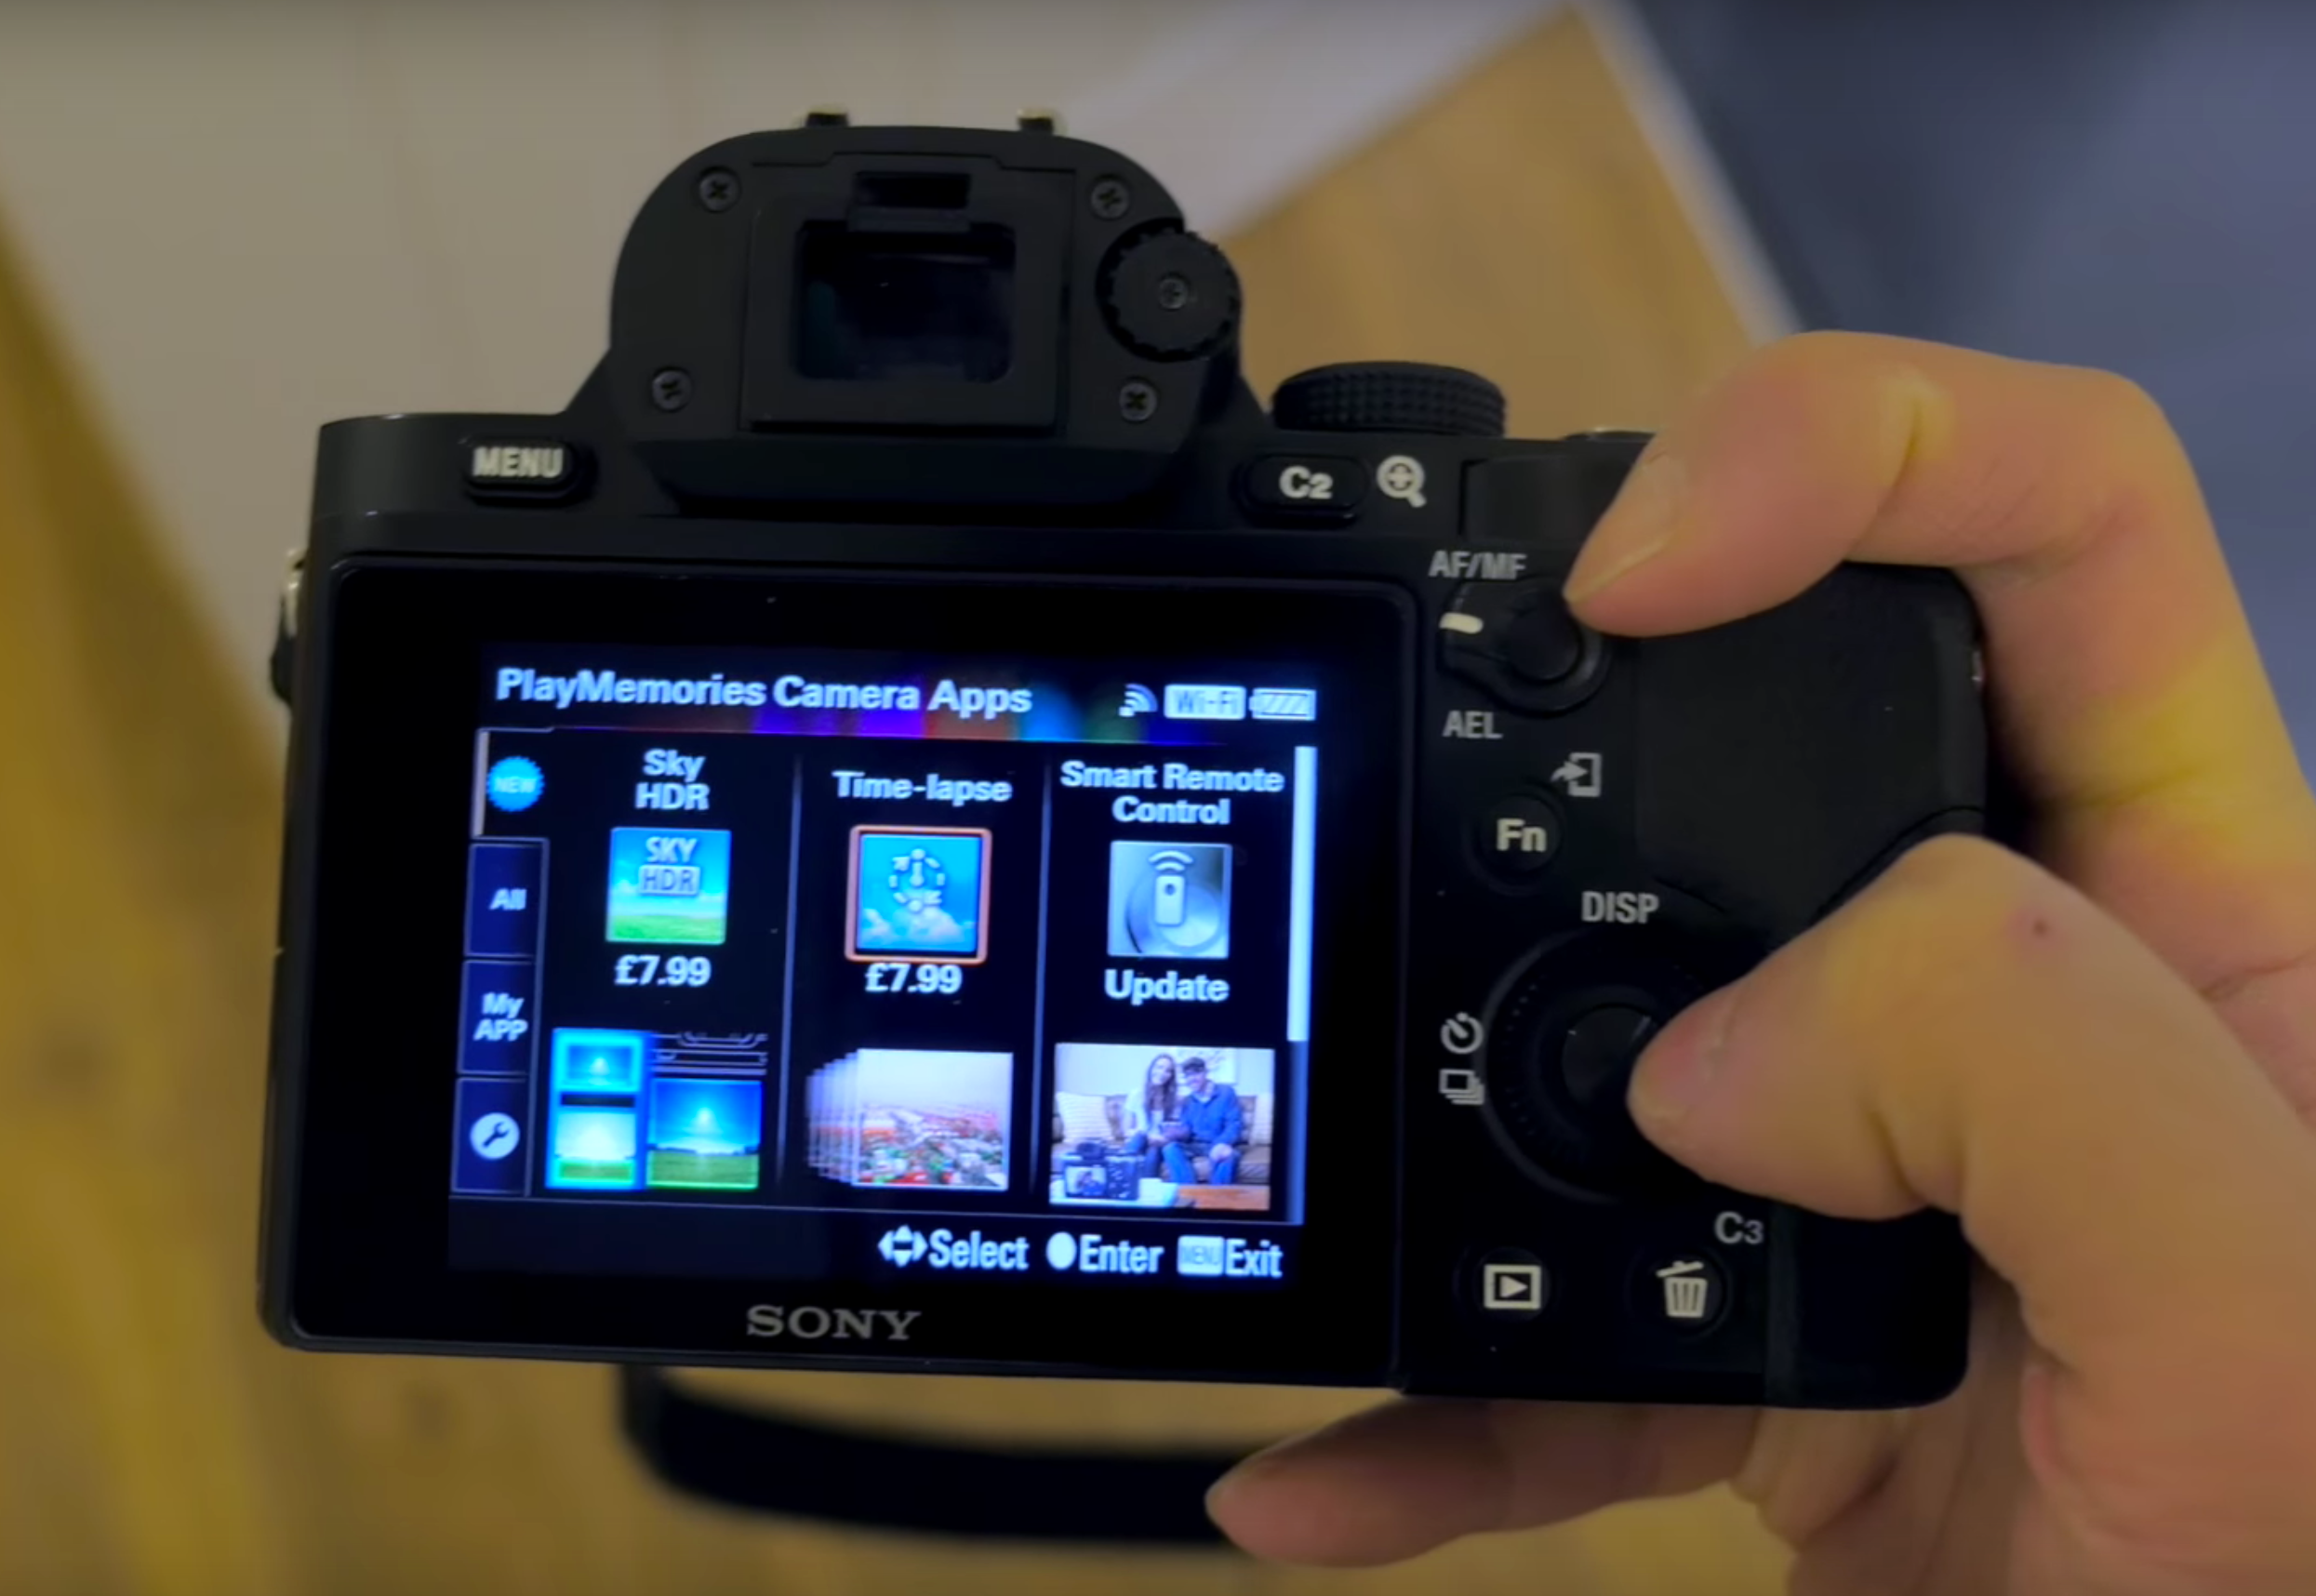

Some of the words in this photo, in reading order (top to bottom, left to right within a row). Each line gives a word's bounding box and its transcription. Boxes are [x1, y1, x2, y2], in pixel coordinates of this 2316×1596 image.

[473, 446, 564, 478] MENU
[1279, 465, 1334, 499] C2
[1429, 550, 1527, 580] AF/MF
[496, 667, 766, 709] PlayMemories
[773, 675, 921, 710] Camera
[927, 679, 1032, 720] Apps
[1443, 711, 1503, 739] AEL
[643, 749, 705, 782] Sky
[1060, 760, 1157, 789] Smart
[1163, 763, 1284, 792] Remote
[634, 783, 710, 810] HDR
[832, 770, 1013, 806] Time-lapse
[1111, 795, 1231, 825] Control
[646, 837, 698, 863] SKY
[1496, 818, 1547, 852] Fn
[642, 868, 697, 893] HDR
[489, 888, 526, 911] All
[1581, 890, 1659, 924] DISP
[613, 954, 712, 986] £7.99
[864, 963, 963, 994] £7.99
[1105, 969, 1230, 1005] Update
[482, 993, 524, 1018] My
[474, 1019, 527, 1042] APP
[1714, 1212, 1764, 1244] C3
[928, 1229, 1029, 1270] Select
[1079, 1234, 1165, 1274] Enter
[1225, 1238, 1284, 1278] Exit
[747, 1305, 922, 1341] SONY
